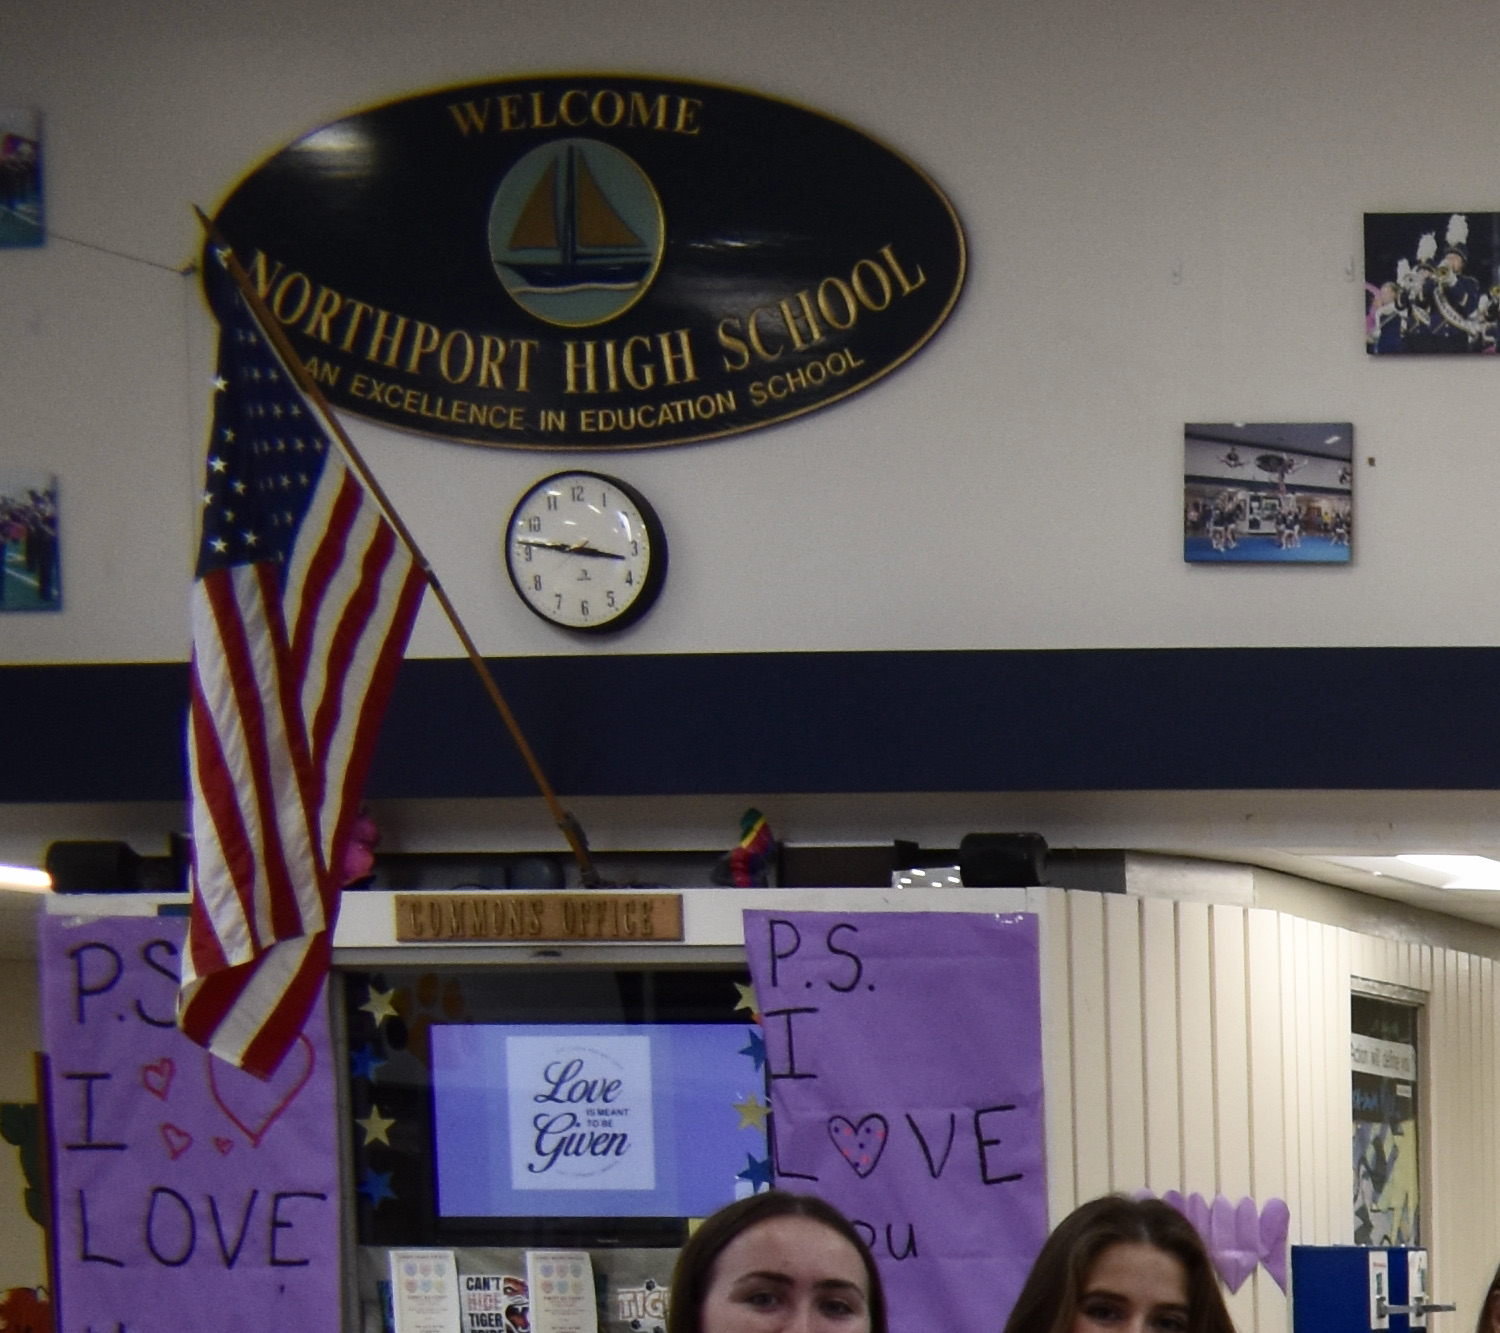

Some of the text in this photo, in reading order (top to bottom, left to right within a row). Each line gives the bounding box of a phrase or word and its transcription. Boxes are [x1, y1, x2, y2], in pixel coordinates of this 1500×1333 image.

[448, 89, 702, 138] WELCOME
[247, 243, 926, 395] NORTHPORT HIGH SCHOOL
[303, 347, 864, 432] AN EXCELLENCE IN EDUCATION SCHOOL
[572, 486, 584, 502] 12
[631, 540, 638, 556] 3
[534, 575, 541, 590] 8
[626, 570, 632, 586] 4
[555, 594, 562, 610] 7
[582, 601, 589, 616] 6
[607, 591, 614, 607] 5
[410, 900, 654, 936] COMMONS OFFICE
[767, 919, 875, 994] P.S.
[763, 1007, 818, 1081] I
[534, 1059, 622, 1105] Love
[62, 1073, 127, 1151] I
[598, 1108, 630, 1117] MEANT
[528, 1112, 631, 1173] Given
[78, 1187, 327, 1269] LOVE
[848, 1220, 919, 1261] ou
[466, 1277, 501, 1290] CAN'T
[469, 1294, 501, 1310] HIDE
[469, 1313, 503, 1327] TIGER
